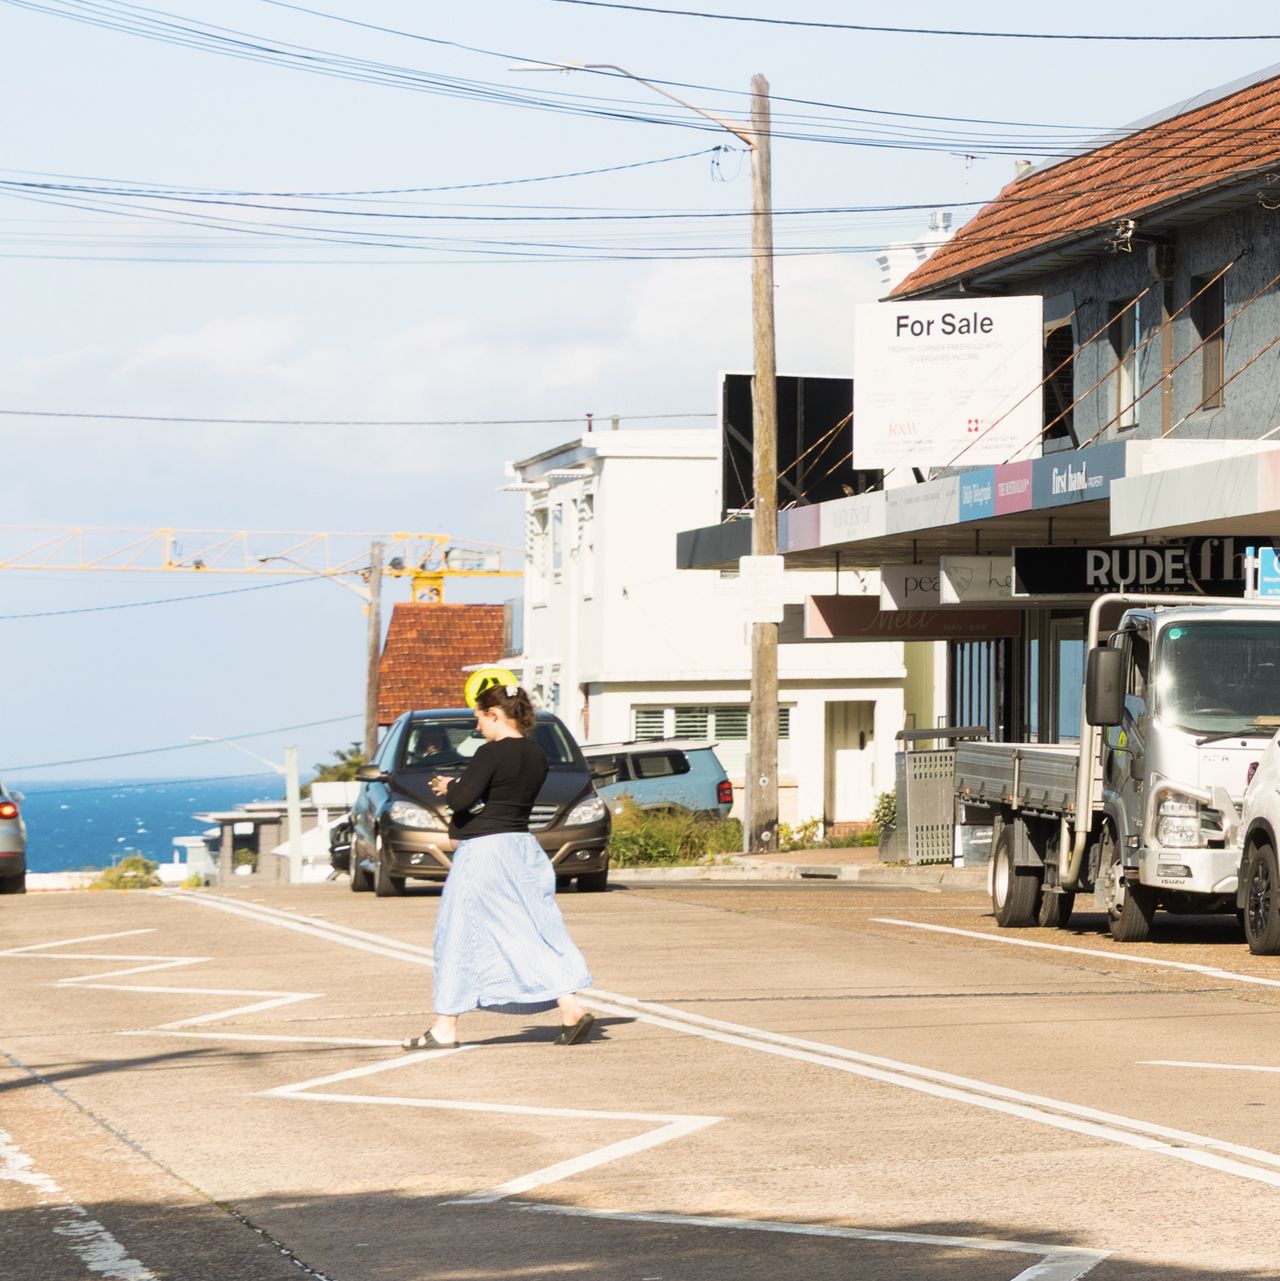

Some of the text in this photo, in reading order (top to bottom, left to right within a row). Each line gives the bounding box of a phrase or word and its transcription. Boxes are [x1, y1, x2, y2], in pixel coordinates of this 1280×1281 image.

[896, 312, 994, 337] For Sale
[1052, 467, 1067, 495] first
